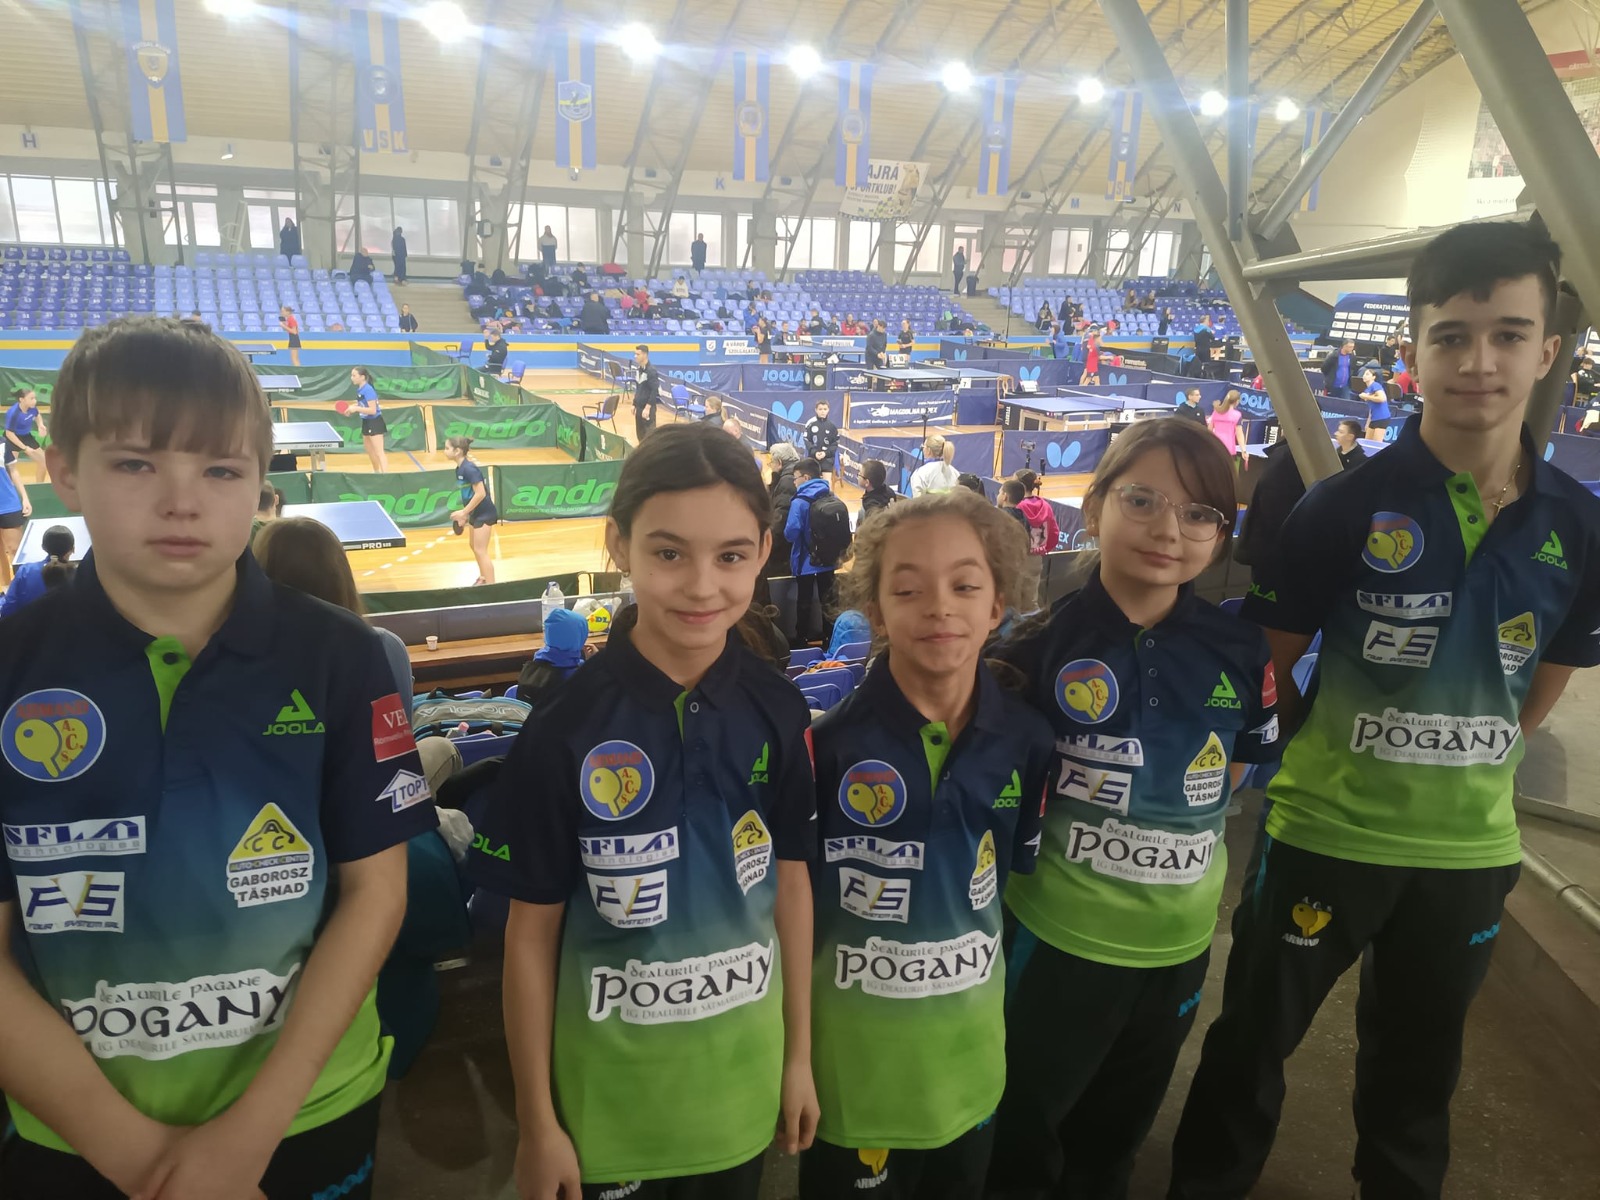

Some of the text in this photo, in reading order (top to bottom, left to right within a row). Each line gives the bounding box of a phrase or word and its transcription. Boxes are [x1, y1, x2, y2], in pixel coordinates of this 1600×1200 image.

[22, 133, 37, 148] H
[868, 163, 899, 181] AJRÁ
[715, 178, 725, 191] K
[1070, 198, 1080, 209] M
[1173, 203, 1181, 213] N
[1391, 304, 1411, 312] ROMÂN
[374, 376, 456, 392] andro
[668, 370, 711, 383] JOOLA
[762, 369, 804, 382] JOOLA
[1240, 392, 1270, 410] OOLA
[444, 419, 547, 439] andro
[511, 479, 618, 507] andr
[1530, 552, 1568, 570] JOOLA
[1248, 582, 1277, 602] OLA
[1204, 697, 1242, 709] JOOLA
[262, 722, 326, 736] JOOLA
[1355, 717, 1520, 760] POGANY
[992, 798, 1019, 809] JOOL
[9, 839, 140, 856] echnologies
[472, 833, 511, 862] OLA
[230, 867, 309, 888] GABOROSZ
[237, 883, 305, 903] TĂȘNAD
[838, 937, 1000, 983] POGANY
[190, 975, 261, 998] PAGANE
[594, 948, 773, 1014] POGANY
